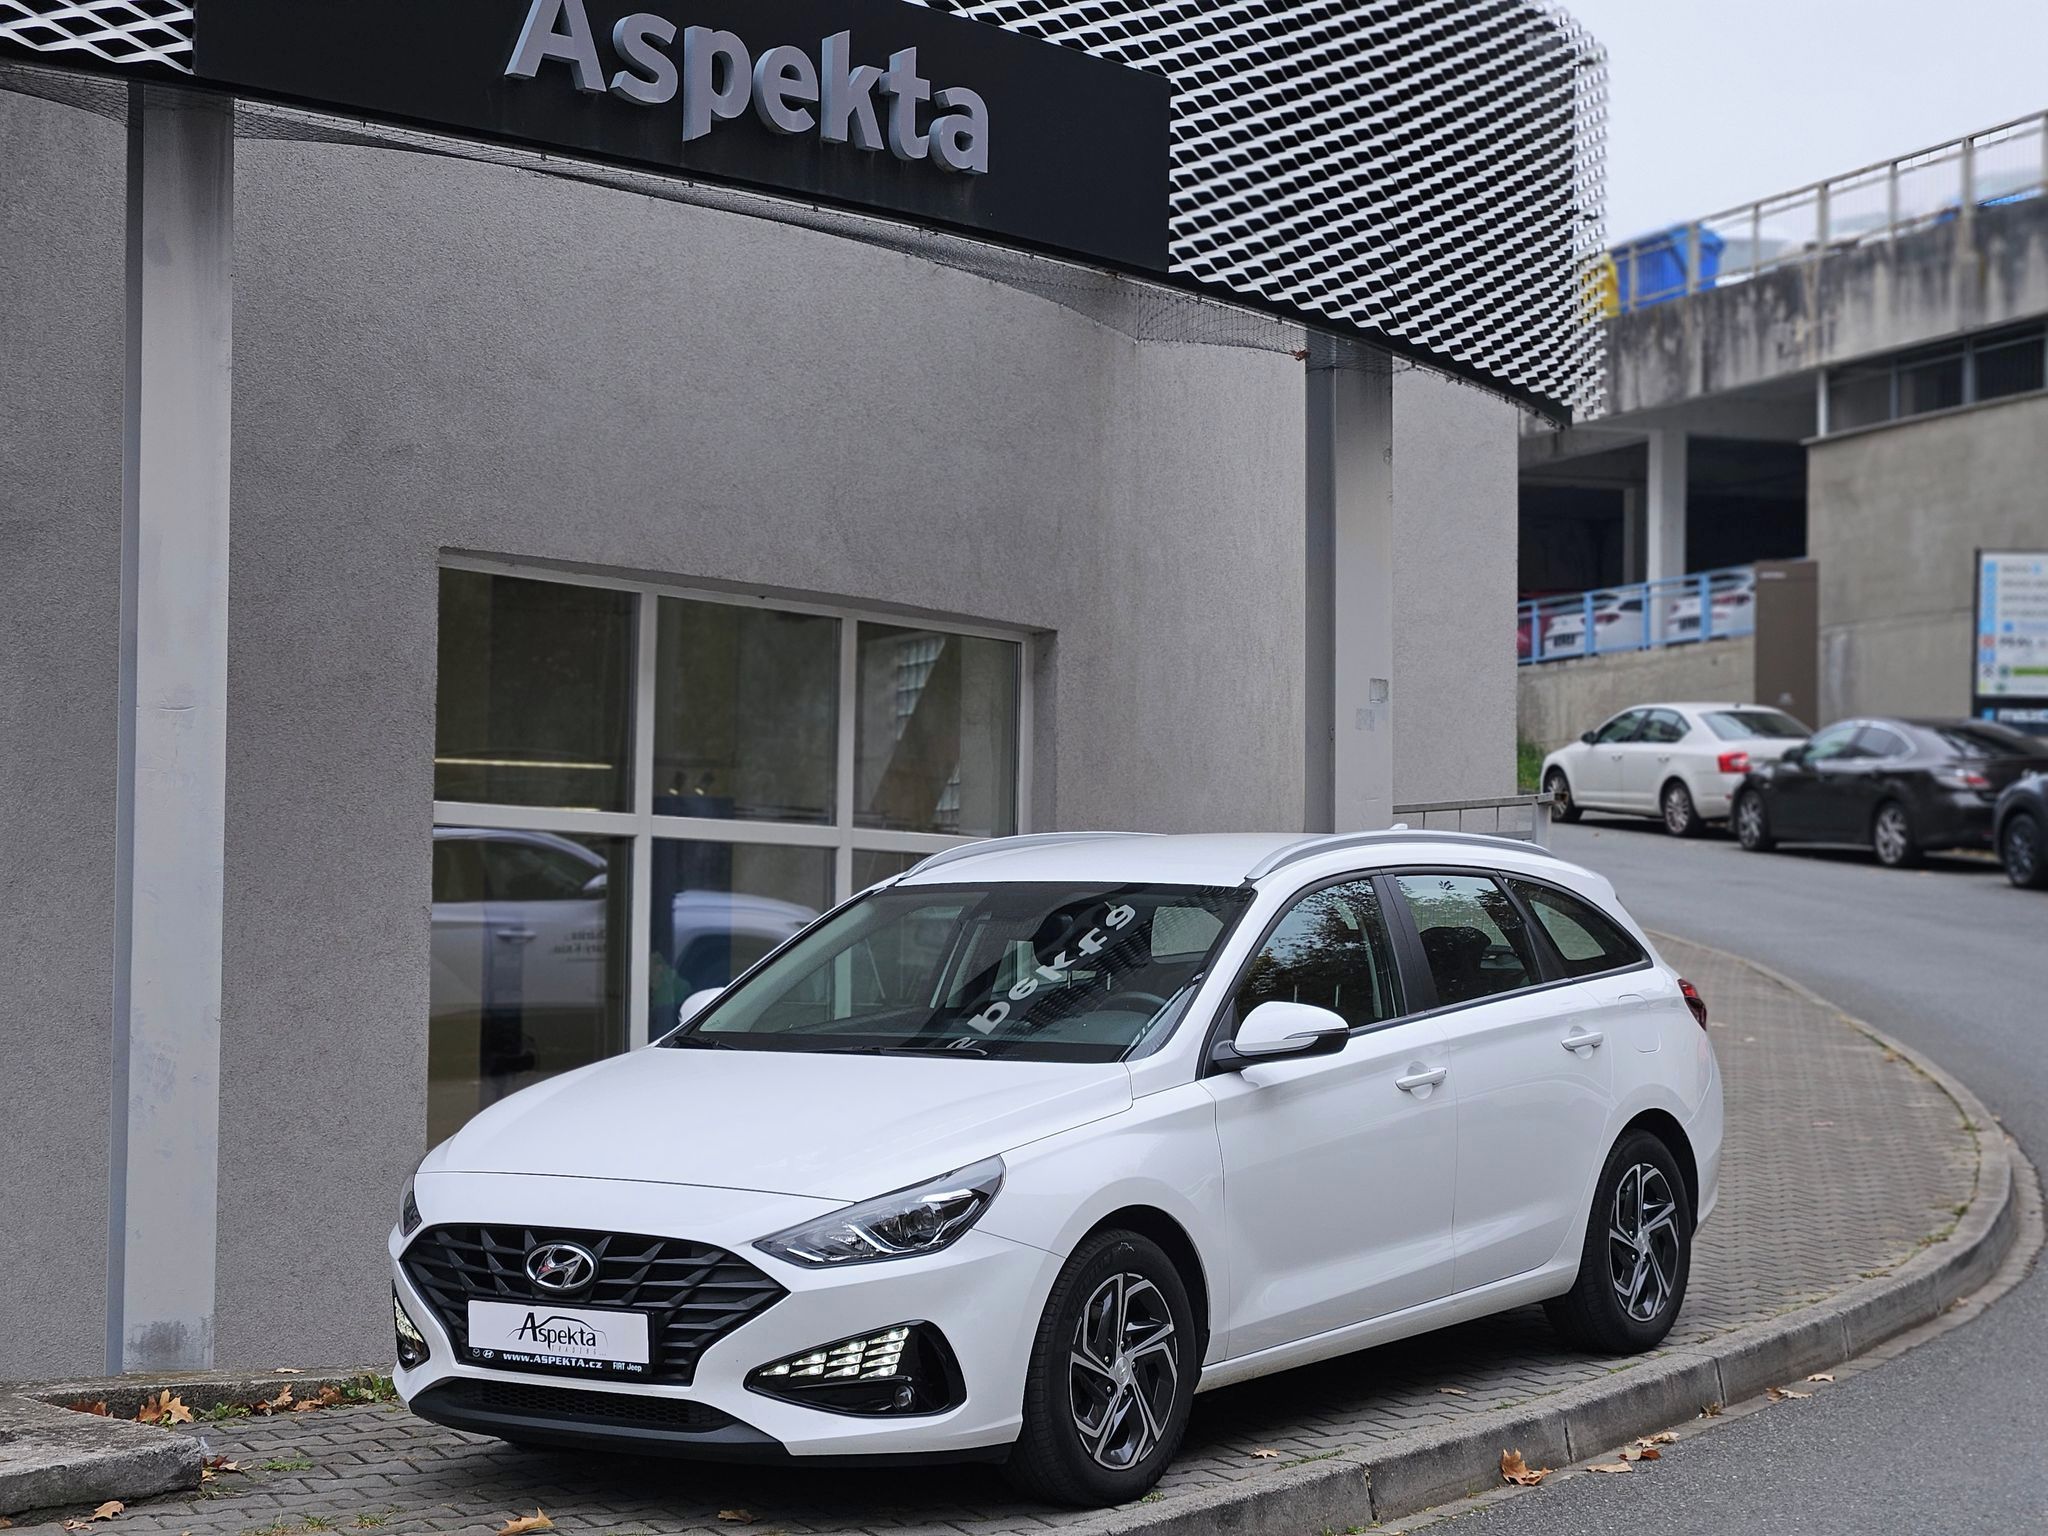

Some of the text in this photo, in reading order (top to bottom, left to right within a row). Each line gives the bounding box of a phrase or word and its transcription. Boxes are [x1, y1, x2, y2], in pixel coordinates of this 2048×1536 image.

[504, 0, 989, 174] Aspekta
[518, 1312, 596, 1350] Aspekta
[503, 1352, 602, 1369] www.ASPEKTA.cz
[626, 1363, 643, 1373] Jeep
